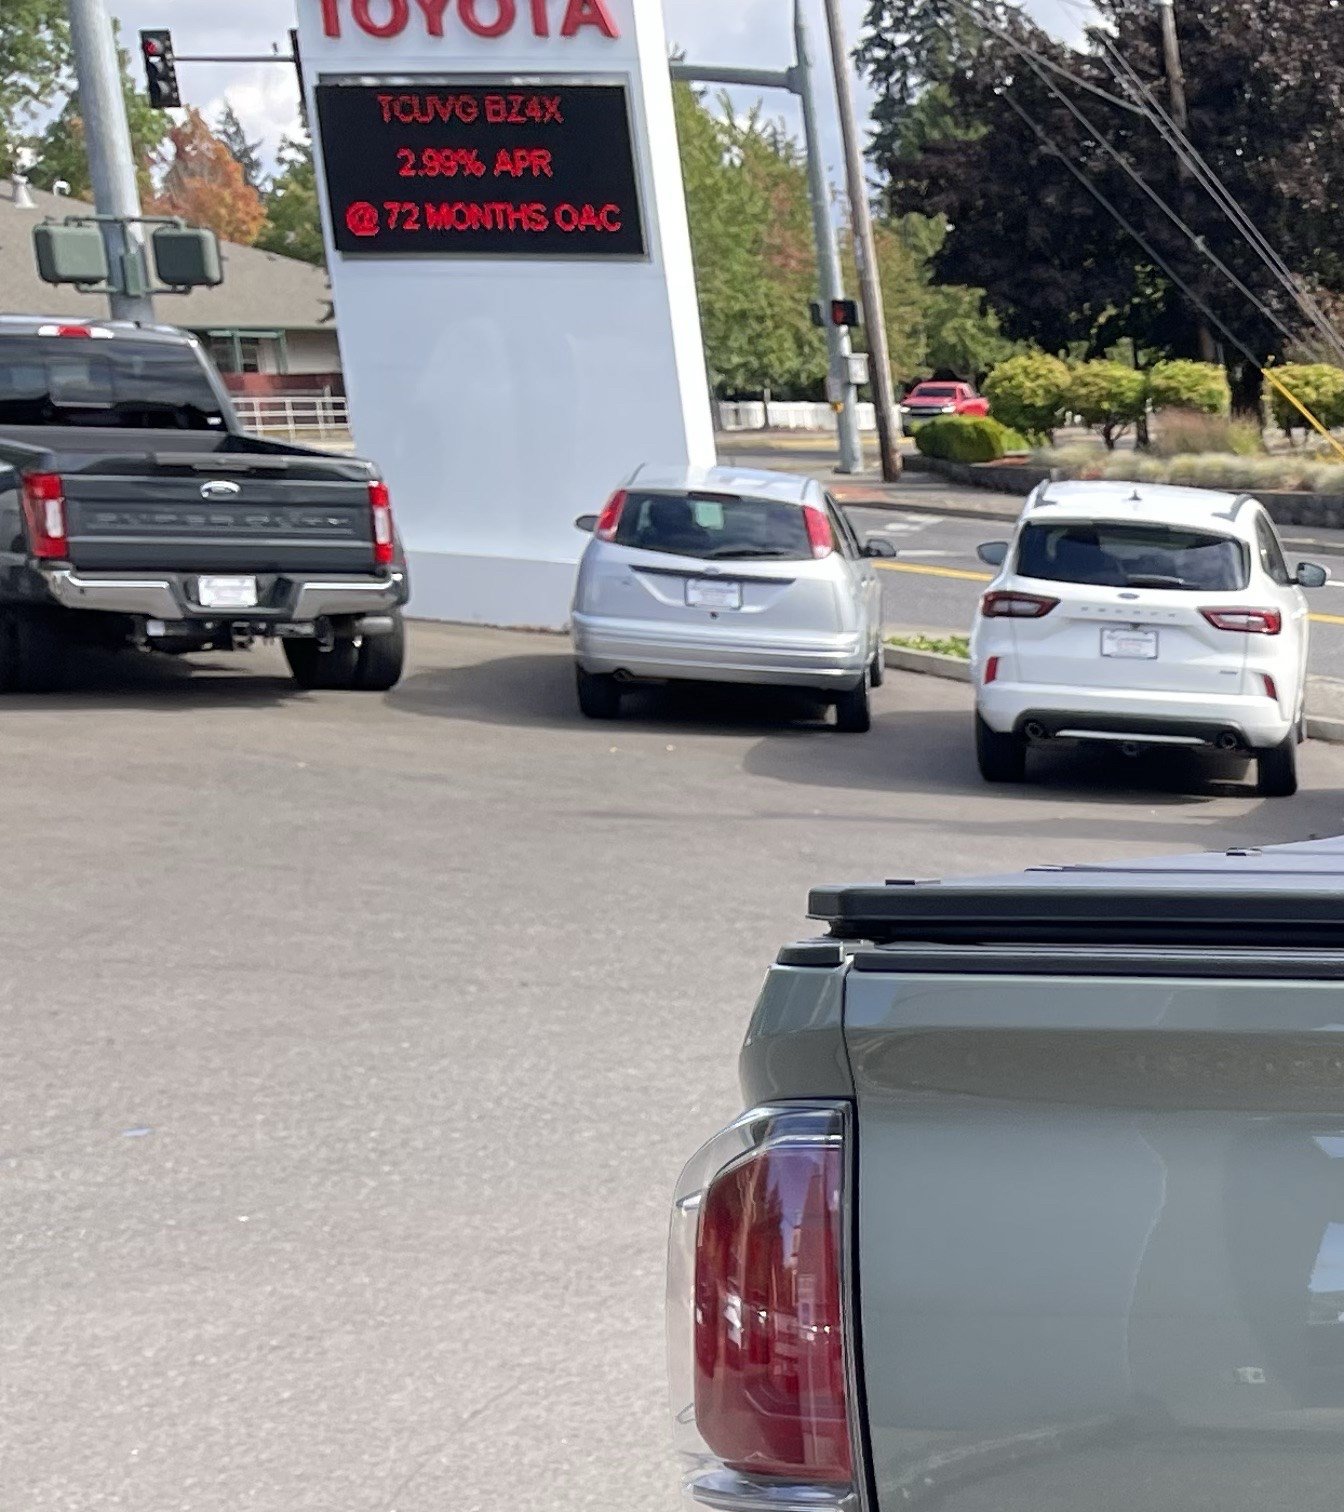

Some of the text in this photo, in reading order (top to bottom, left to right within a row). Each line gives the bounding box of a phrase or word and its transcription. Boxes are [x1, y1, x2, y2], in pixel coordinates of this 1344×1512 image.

[318, 0, 619, 38] TOYOTA
[377, 94, 564, 123] TCUVG BZ4X
[397, 148, 553, 177] 2.99% APR
[346, 201, 622, 236] @ 72 MONTHS OAC
